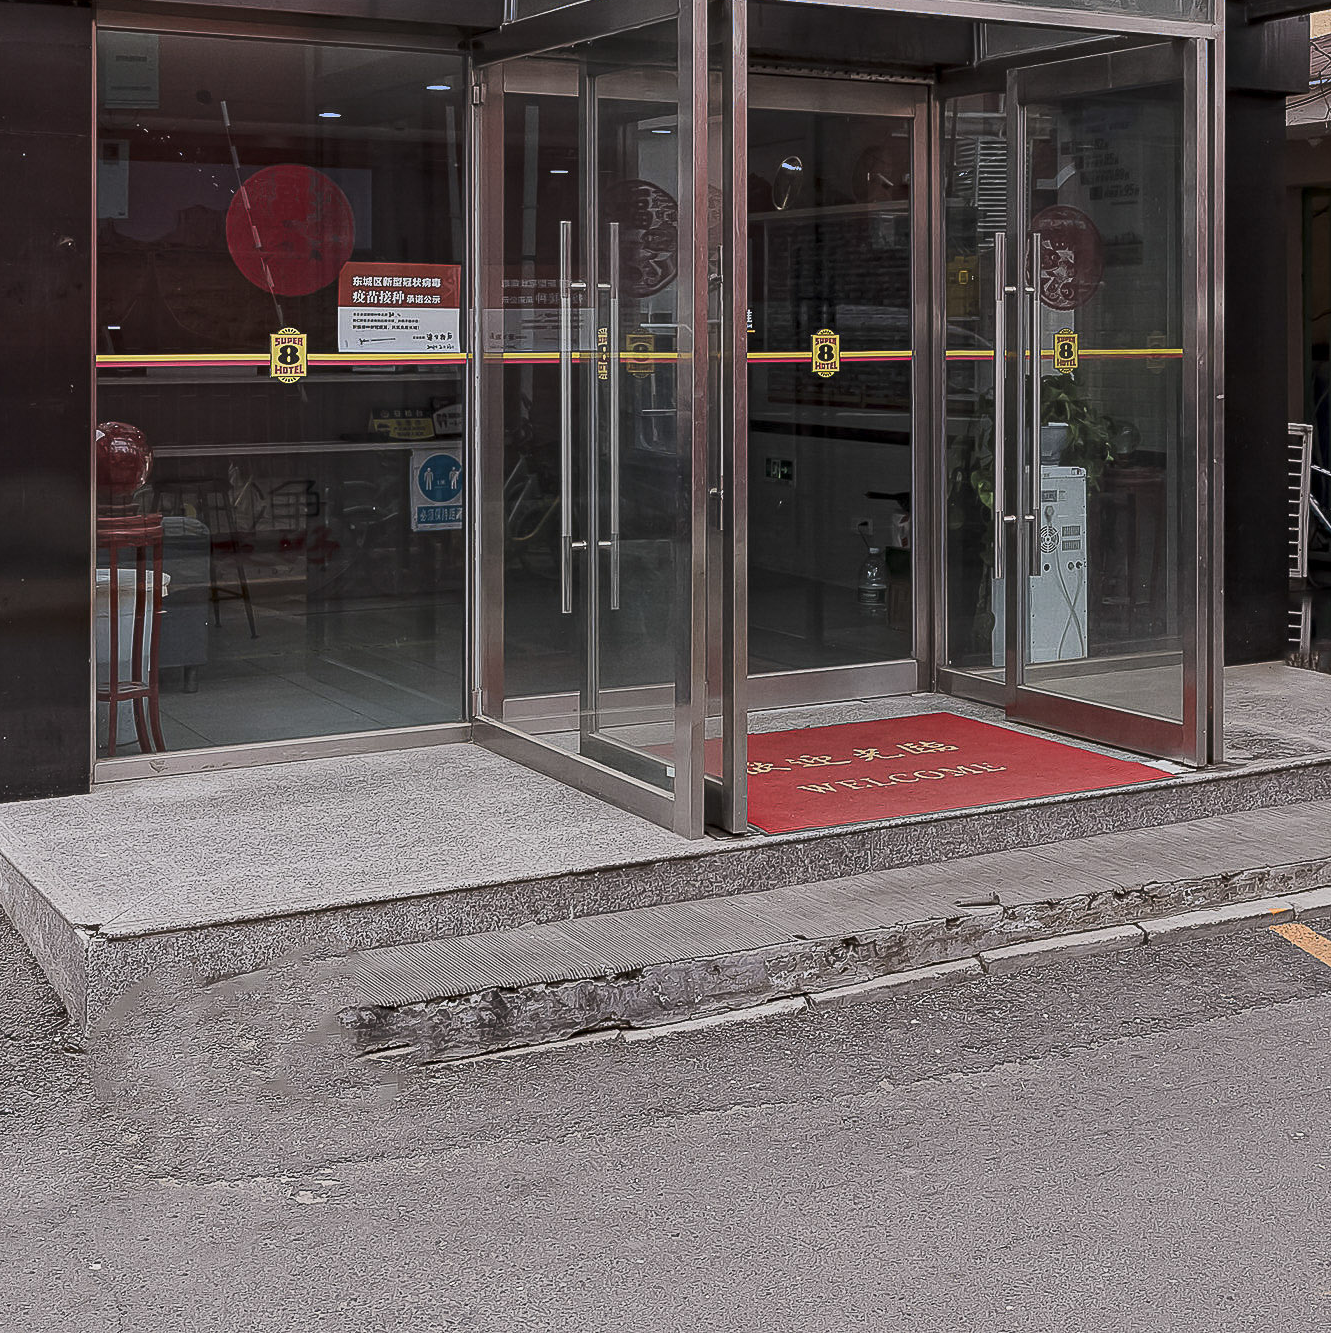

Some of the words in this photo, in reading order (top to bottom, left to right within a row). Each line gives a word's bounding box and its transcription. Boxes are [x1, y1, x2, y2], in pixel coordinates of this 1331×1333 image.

[352, 276, 441, 288] 东城区新型冠状病毒
[274, 337, 303, 347] SUPER
[814, 337, 837, 346] SUPER
[277, 345, 300, 365] 8
[817, 343, 835, 362] 8
[1059, 342, 1074, 359] 8
[274, 363, 305, 375] HOTEL
[814, 360, 838, 370] HOTEL
[796, 761, 1008, 795] WELCOME
